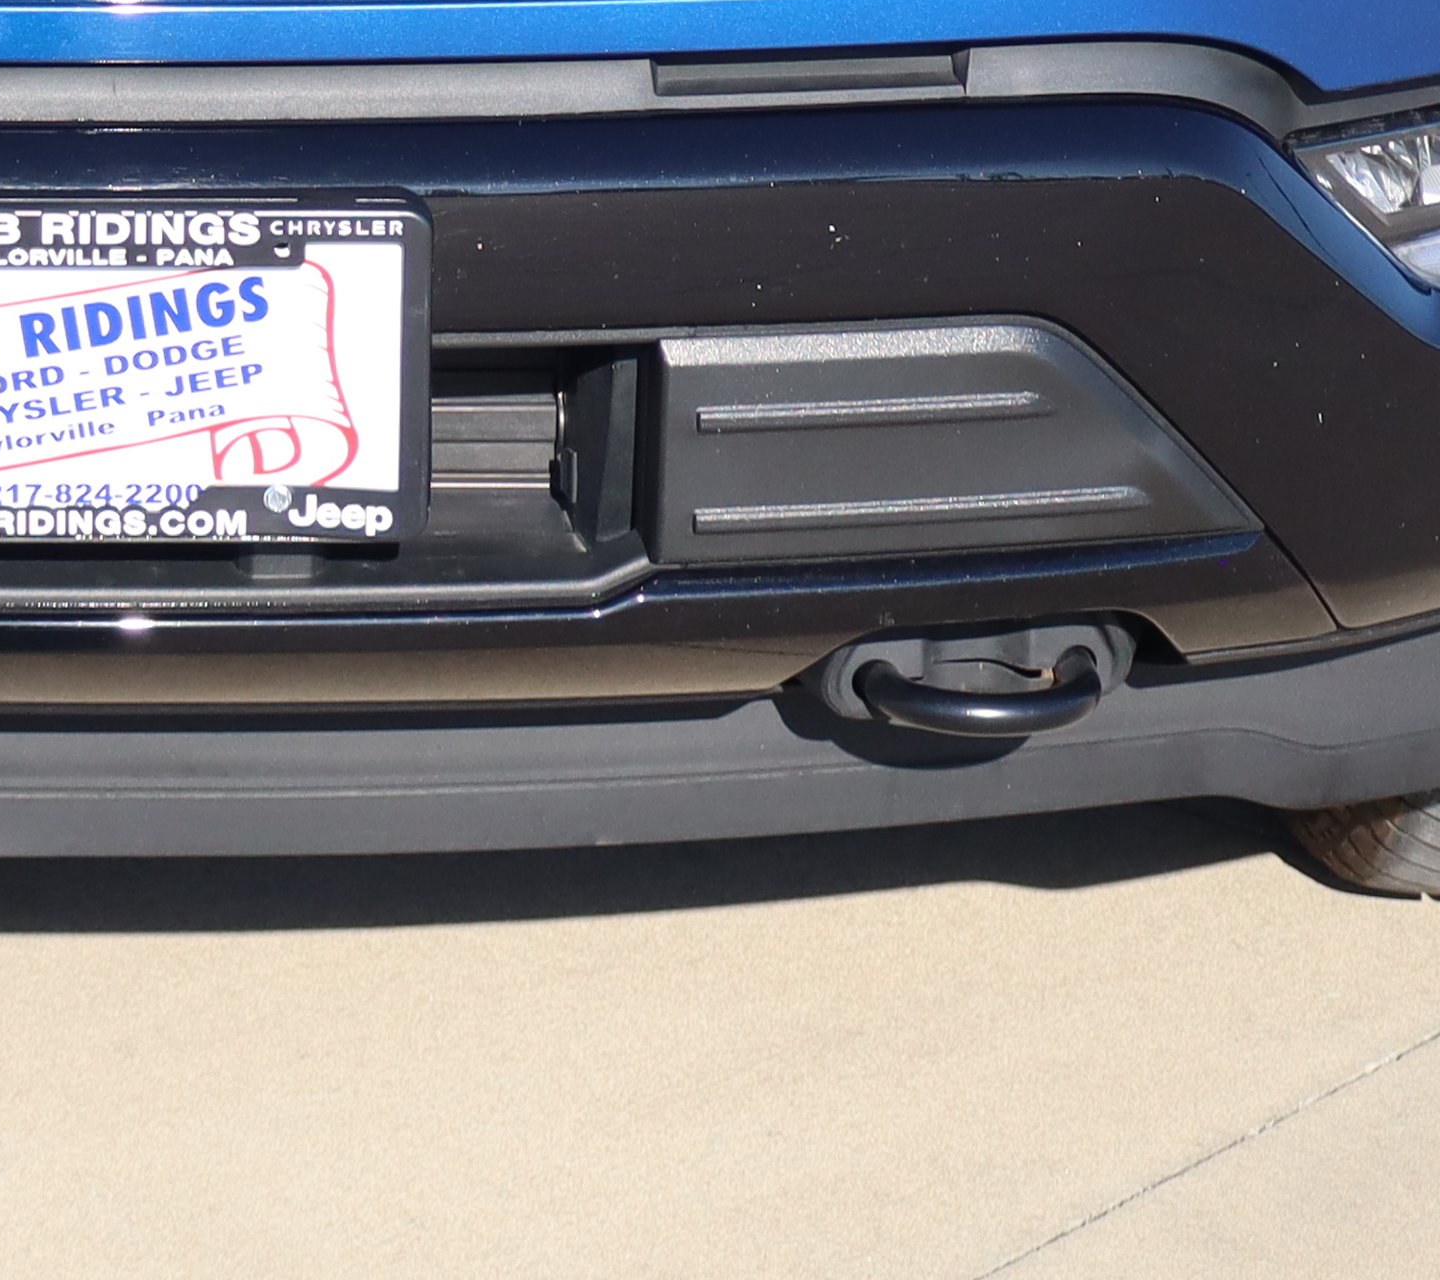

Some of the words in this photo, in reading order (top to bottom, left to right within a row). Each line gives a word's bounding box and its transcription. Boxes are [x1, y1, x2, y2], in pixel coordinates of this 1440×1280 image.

[40, 212, 262, 246] RIDINGS
[269, 219, 404, 236] CHRYSLER
[155, 247, 235, 267] PANA
[18, 275, 269, 359] RIDINGS
[104, 334, 246, 377] DODGE
[164, 362, 264, 397] JEEP
[147, 402, 227, 428] Pana
[287, 493, 394, 537] Jeep
